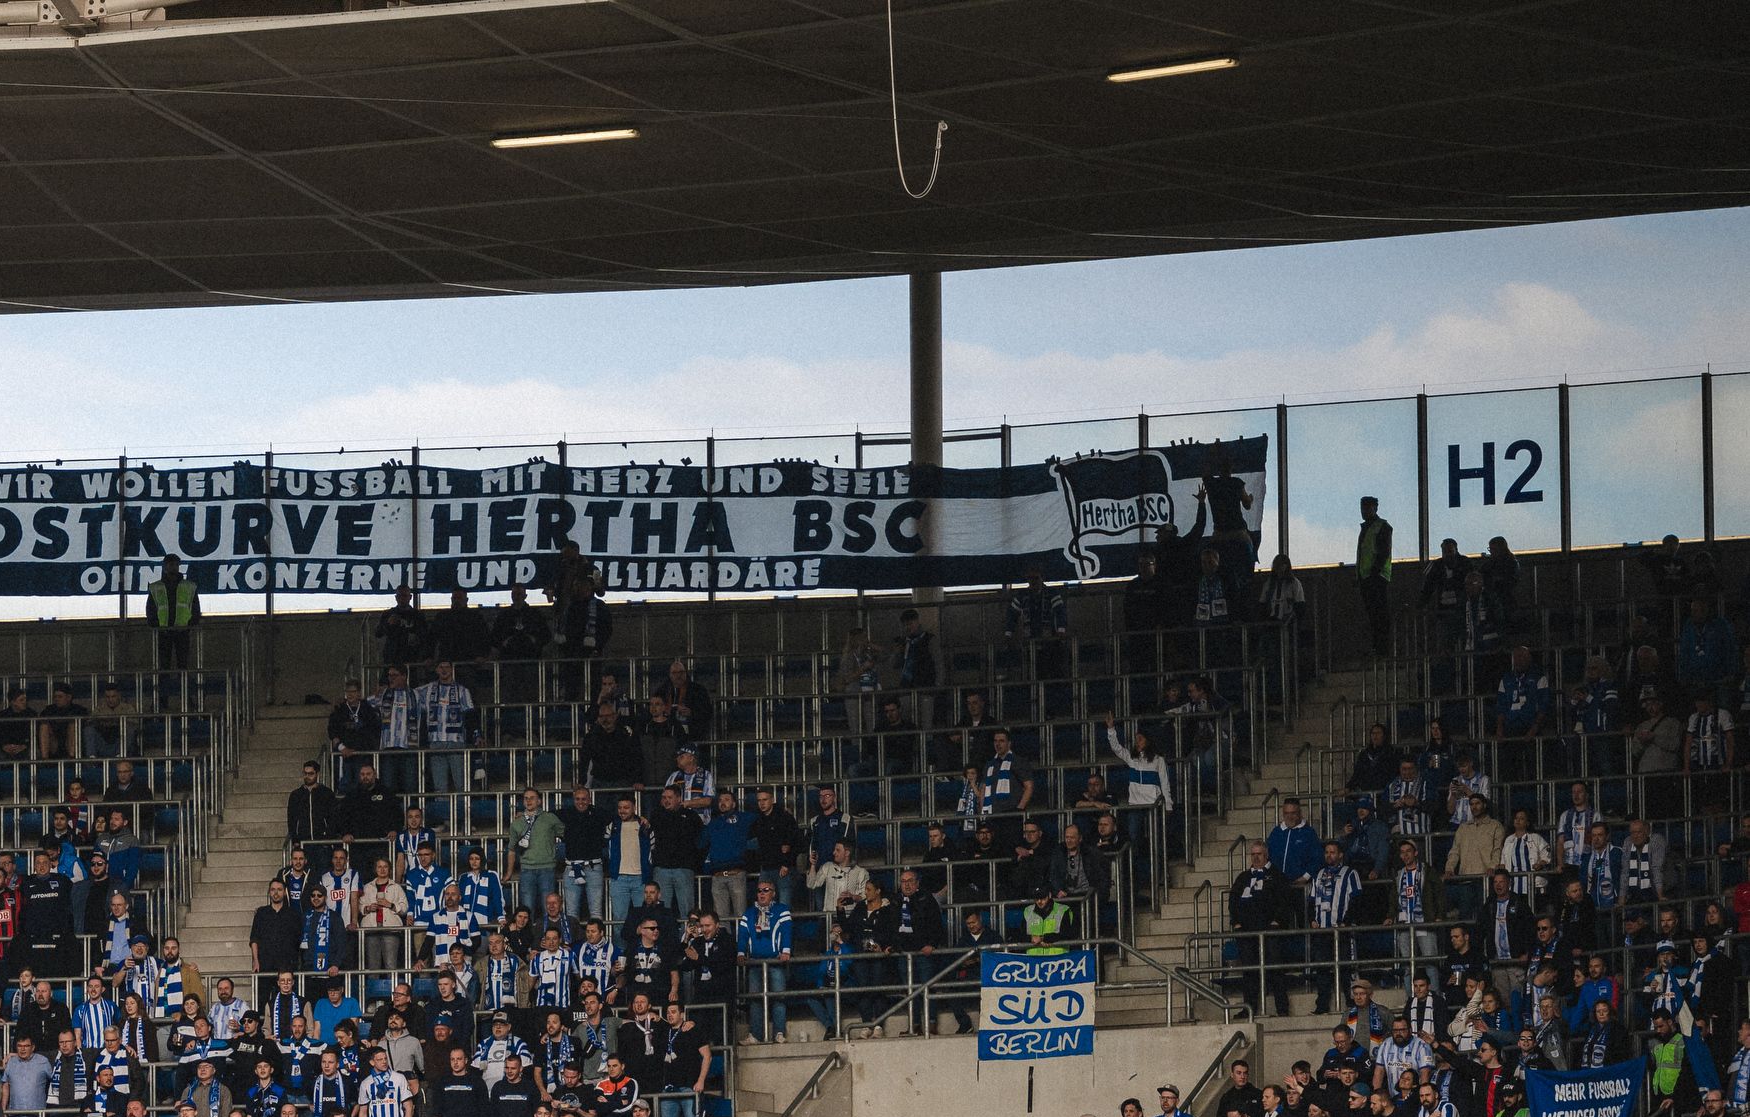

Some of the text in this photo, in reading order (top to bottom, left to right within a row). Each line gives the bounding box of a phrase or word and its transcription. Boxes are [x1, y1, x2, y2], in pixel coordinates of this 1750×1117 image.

[81, 470, 236, 500] WOLLEN
[262, 467, 453, 498] FUSSBALL
[481, 464, 547, 494] MIT
[571, 466, 674, 494] HERZ
[701, 467, 784, 495] UND
[811, 466, 911, 497] SEELE
[1447, 439, 1544, 508] H2
[431, 497, 736, 554] HERTHA
[792, 499, 927, 555] BSC
[80, 557, 822, 593] OHN KONZERNE UND LLIARDÄRE
[30, 891, 59, 900] AUTOHERO
[332, 890, 345, 900] DB
[991, 955, 1088, 984] GRUPPA
[989, 989, 1086, 1026] SÜD
[989, 1028, 1081, 1056] BERLIN
[1554, 1082, 1587, 1103] MEHR
